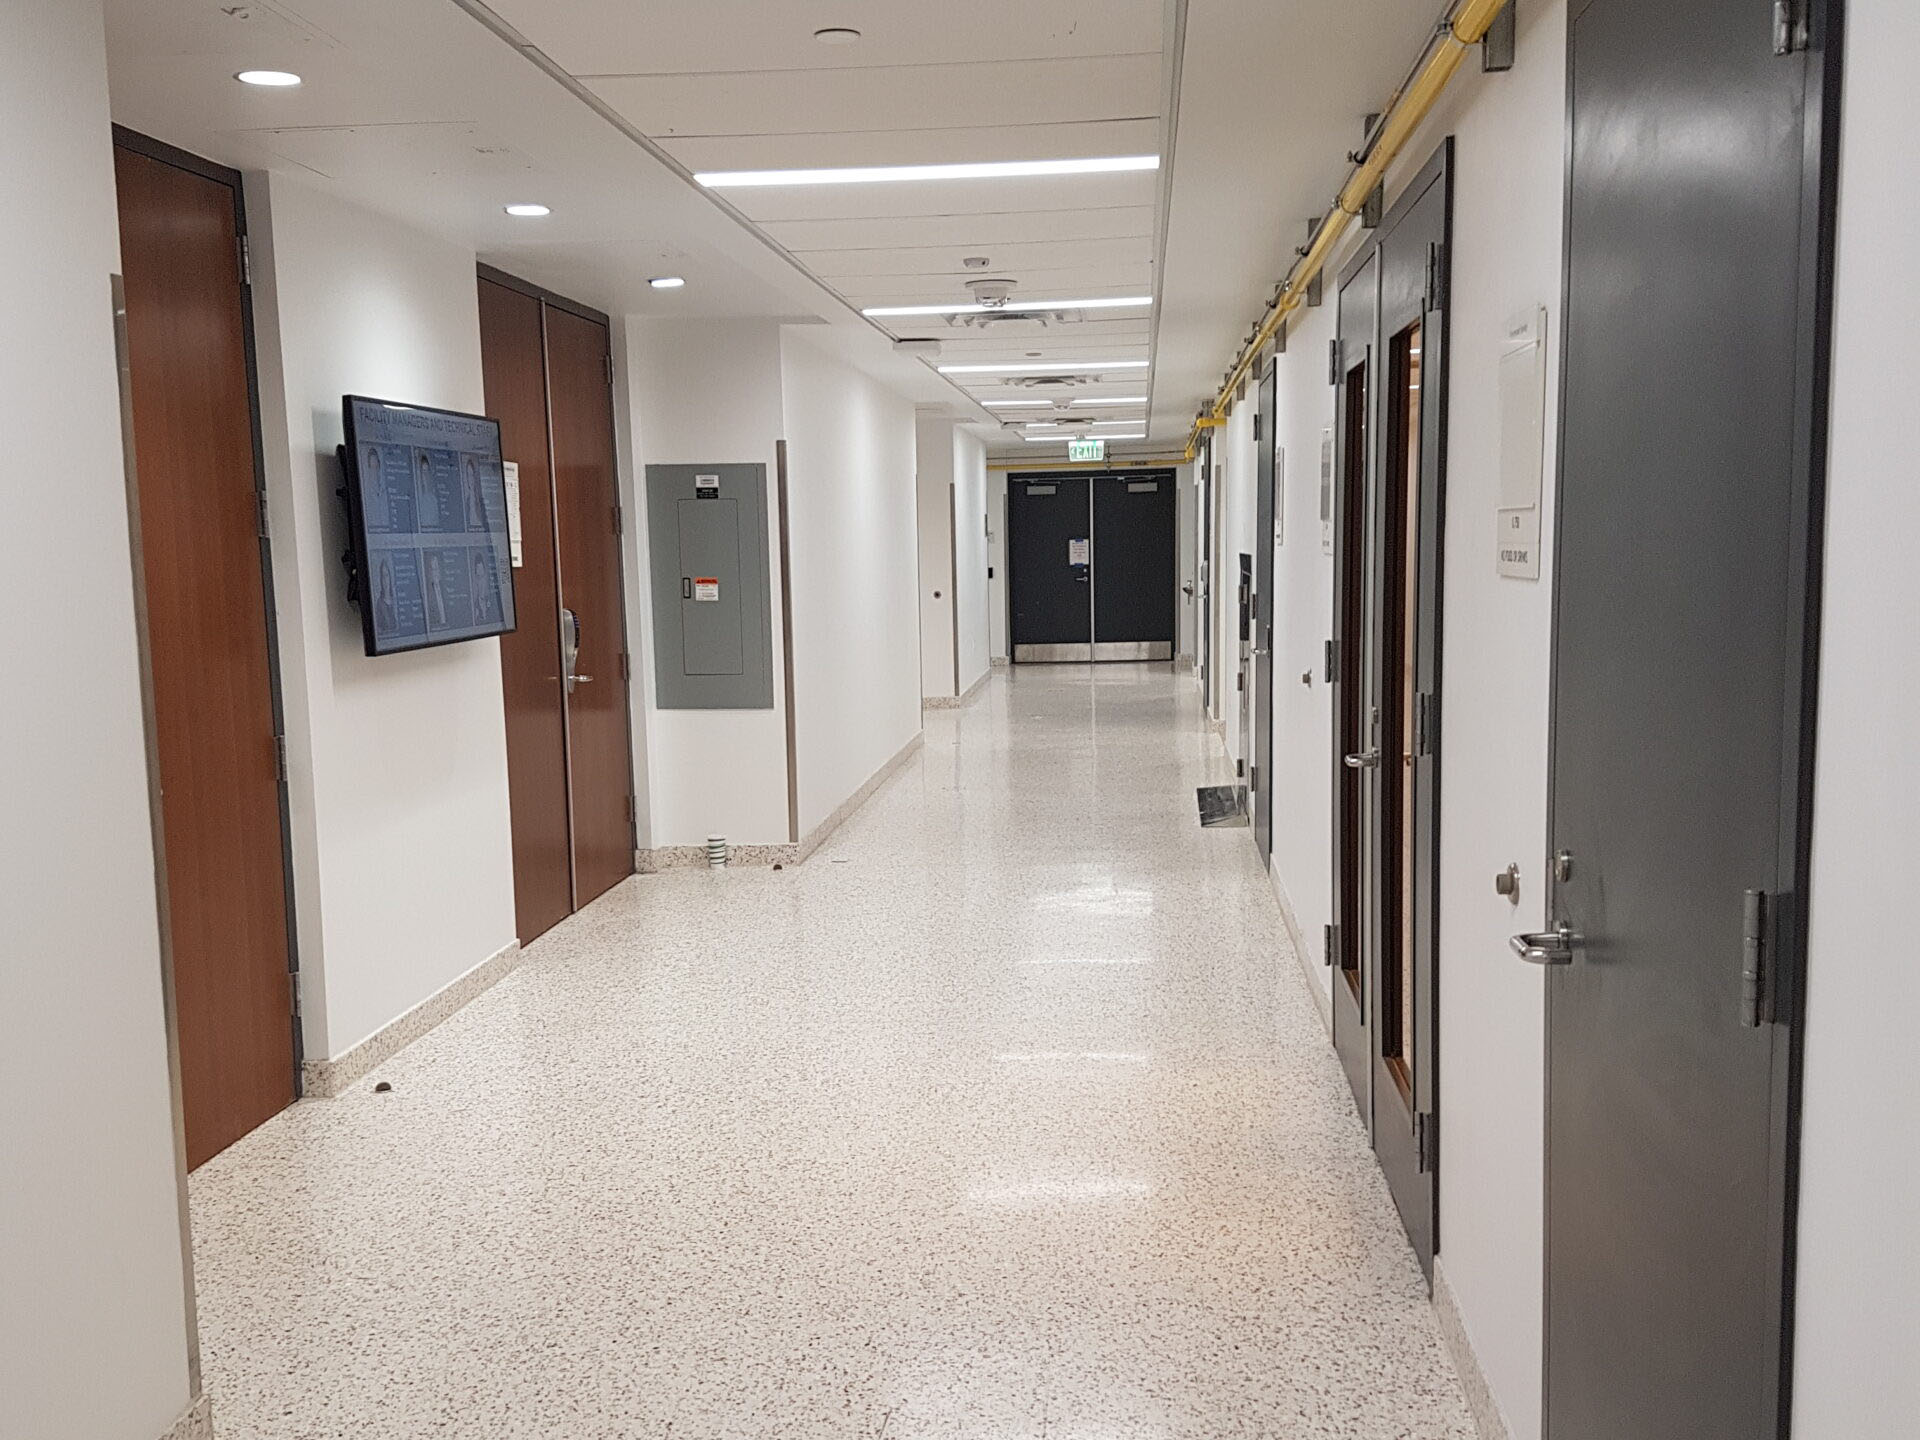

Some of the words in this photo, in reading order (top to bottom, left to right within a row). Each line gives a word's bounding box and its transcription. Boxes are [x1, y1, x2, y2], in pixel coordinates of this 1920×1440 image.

[359, 406, 391, 424] FACILITY
[391, 410, 430, 430] MANAGERS
[430, 417, 443, 432] AND
[443, 418, 476, 435] TECHNICAL
[1077, 445, 1097, 459] EXIT
